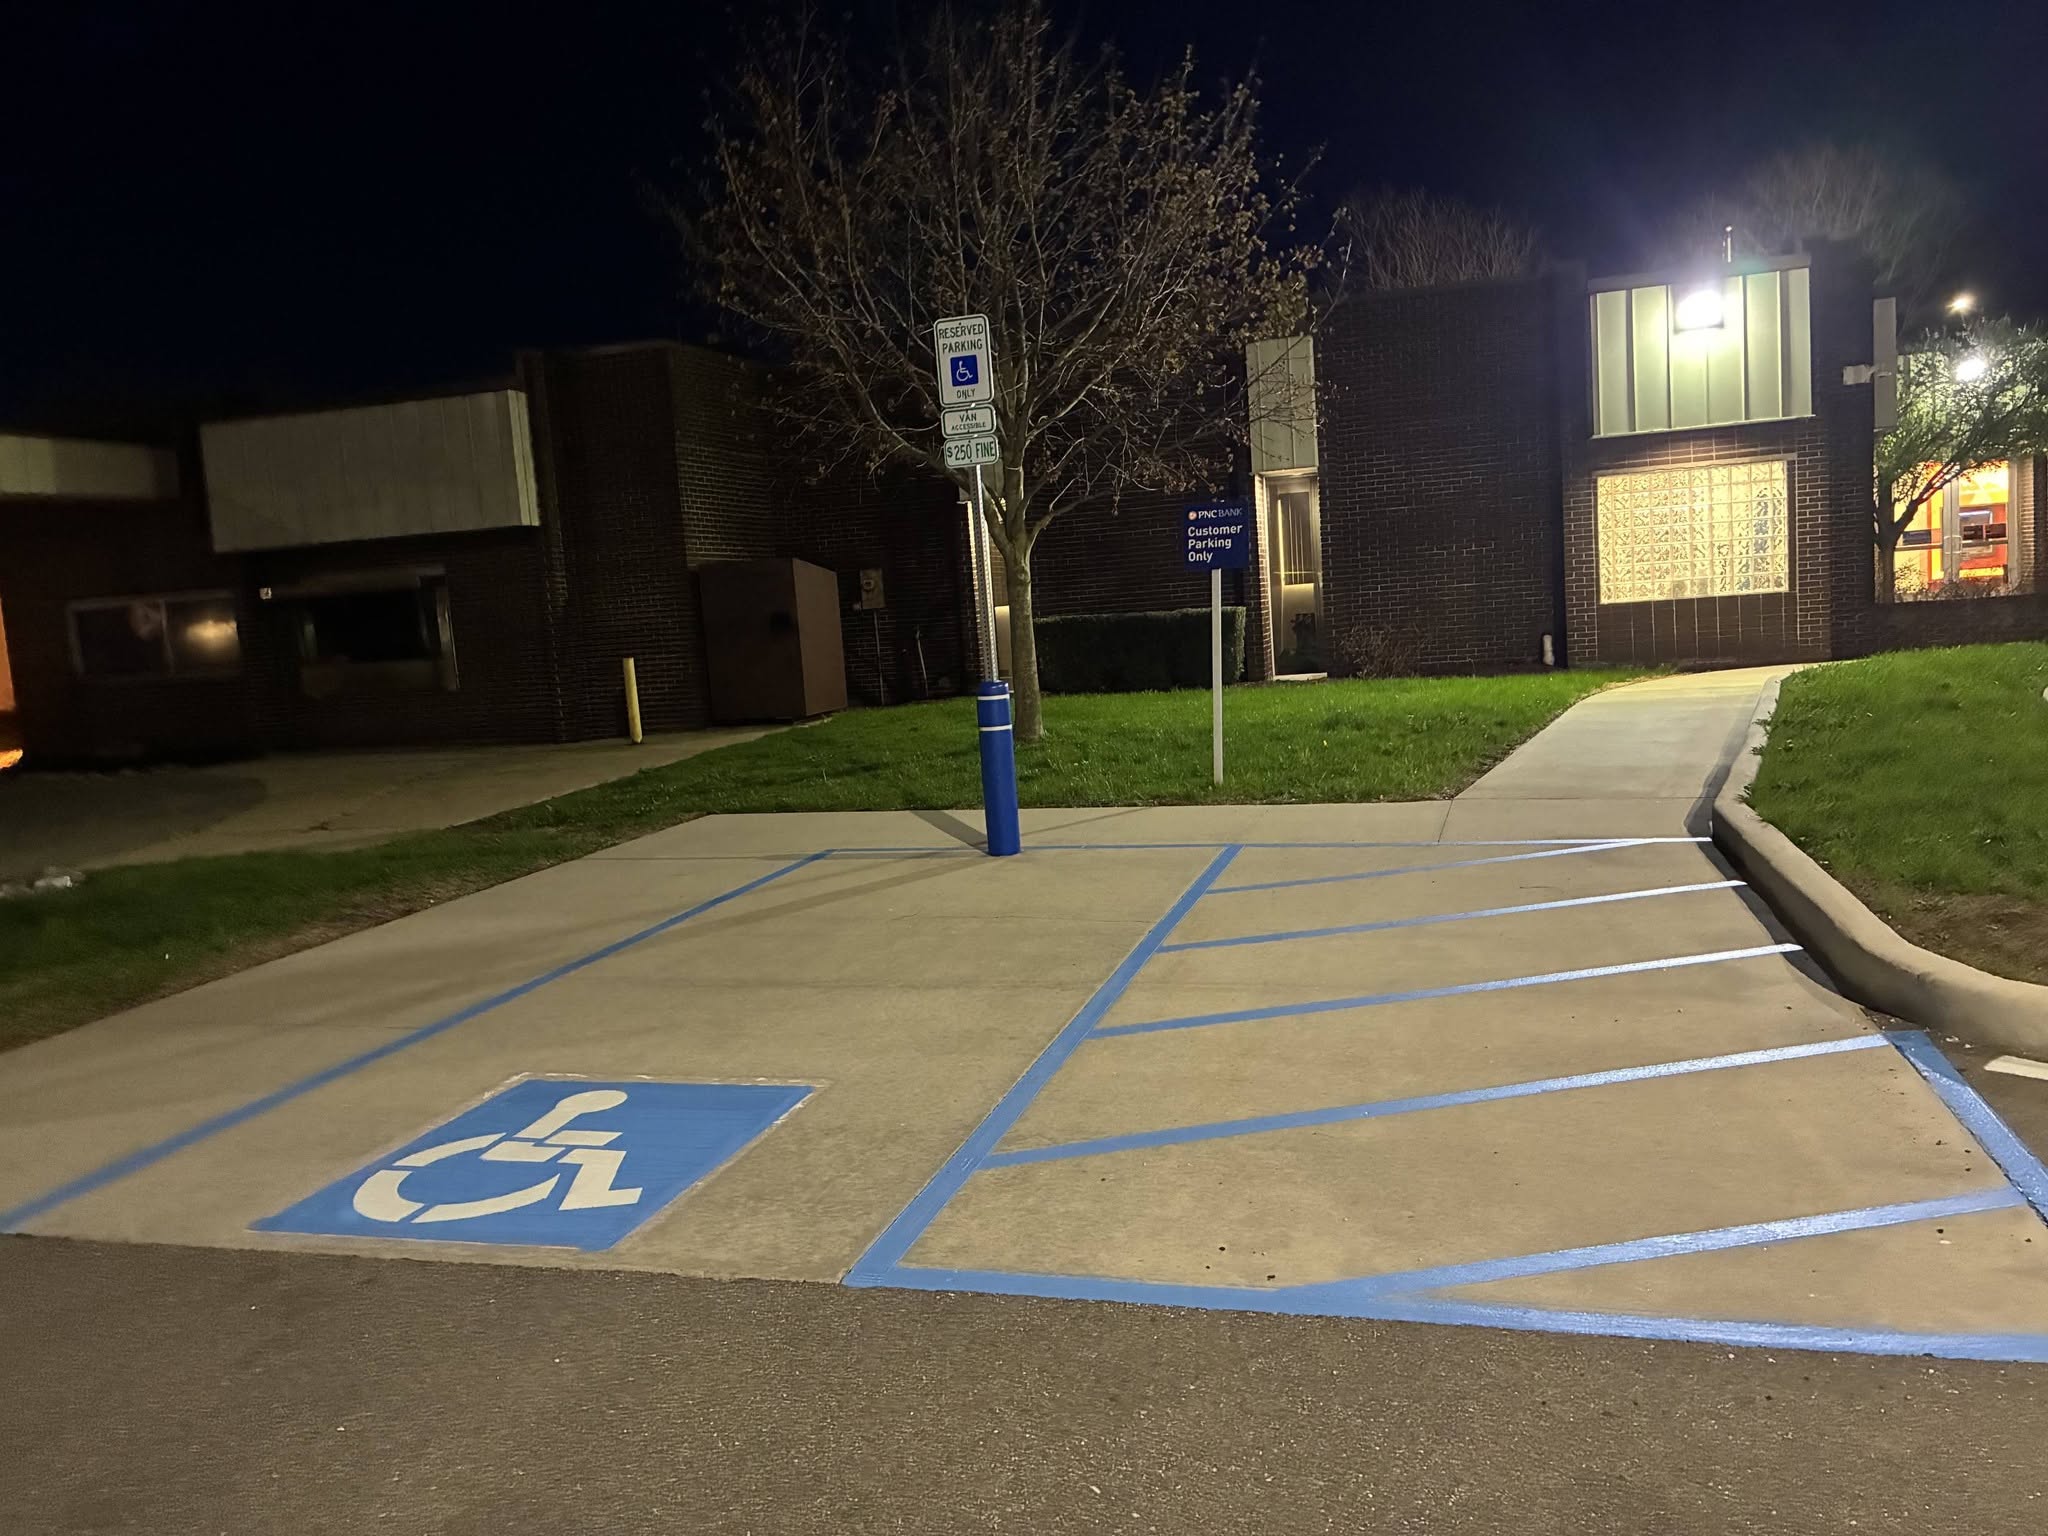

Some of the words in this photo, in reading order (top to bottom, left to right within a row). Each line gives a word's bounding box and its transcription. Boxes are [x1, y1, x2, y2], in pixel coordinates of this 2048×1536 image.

[938, 324, 984, 339] RESERVED
[942, 339, 983, 354] PARKING
[956, 389, 975, 399] ONLY
[959, 413, 977, 423] VAN
[951, 422, 986, 430] ACCESSIBLE
[946, 444, 973, 461] $250
[975, 441, 995, 459] FINE
[1198, 509, 1217, 519] PNC
[1218, 508, 1242, 517] BANK
[1188, 525, 1243, 536] Customer
[1188, 537, 1231, 549] Parking
[1188, 550, 1213, 563] Only
